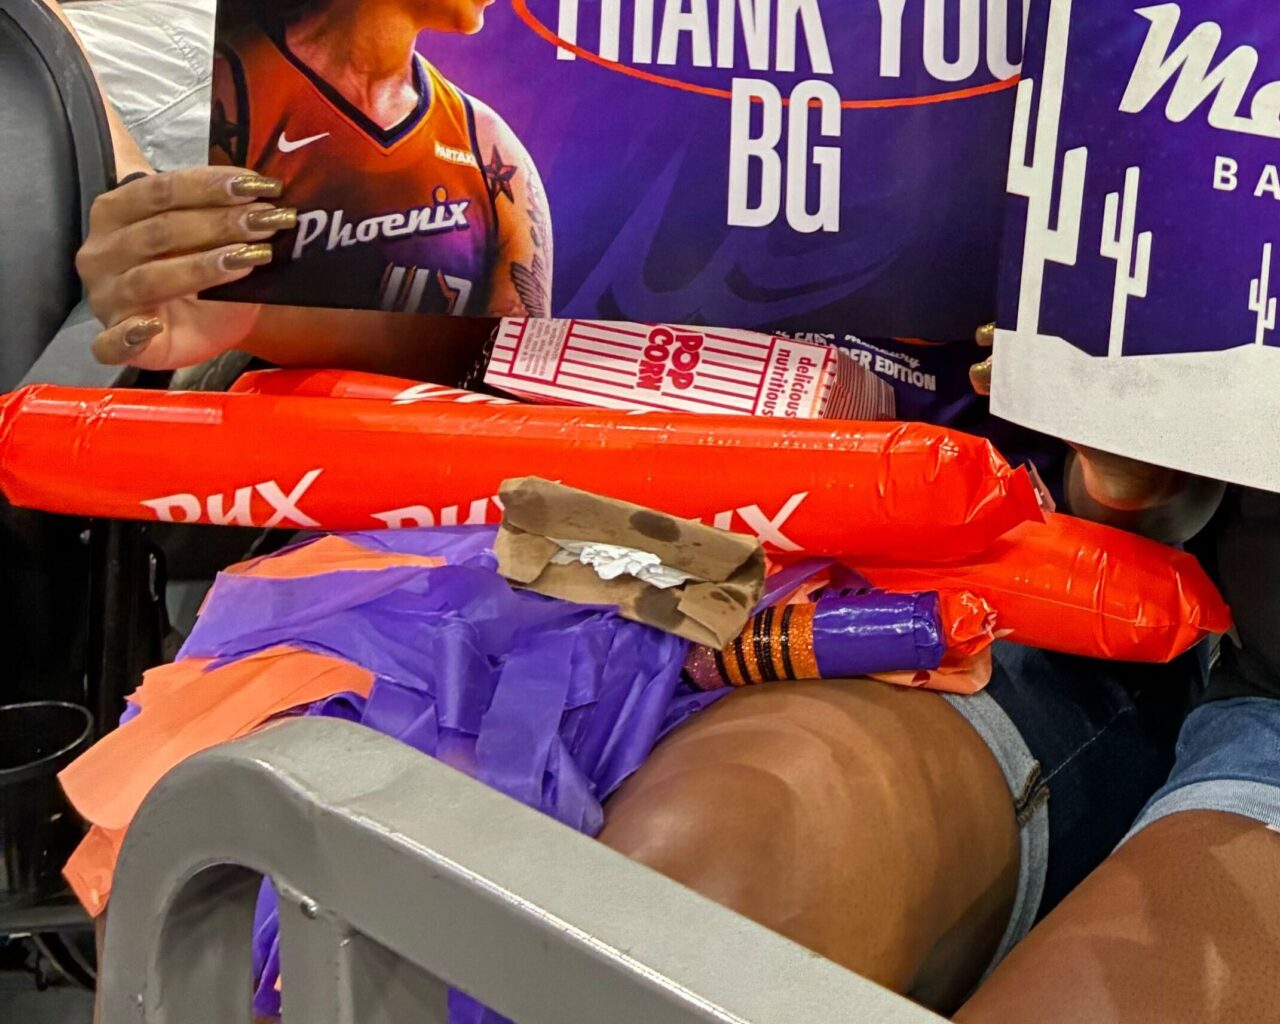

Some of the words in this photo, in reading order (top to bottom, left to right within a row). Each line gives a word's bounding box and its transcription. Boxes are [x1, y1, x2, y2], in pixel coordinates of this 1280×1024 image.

[727, 77, 842, 234] BG
[291, 185, 469, 259] Phoenix
[635, 327, 674, 392] CORN
[667, 334, 704, 390] POP
[761, 348, 792, 417] nutritious
[785, 356, 817, 418] delicious
[874, 356, 937, 392] EDITION
